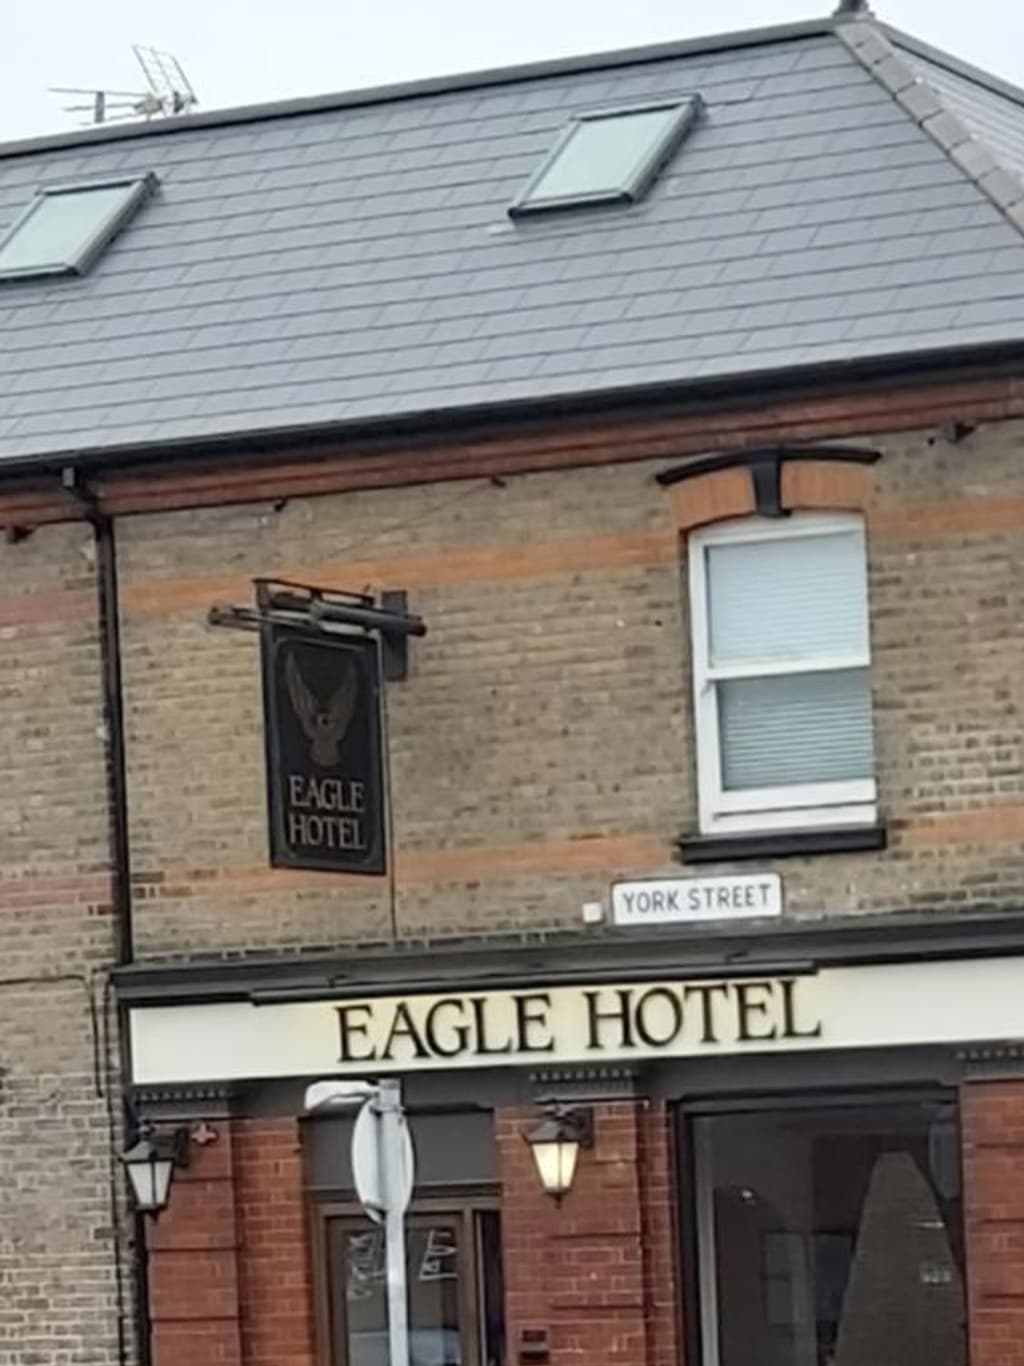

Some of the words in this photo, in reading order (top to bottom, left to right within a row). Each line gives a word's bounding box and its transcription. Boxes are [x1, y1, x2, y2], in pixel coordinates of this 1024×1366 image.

[288, 775, 366, 812] EAGLE
[288, 813, 367, 849] HOTEL
[621, 889, 680, 914] YORK
[687, 883, 772, 911] STREET
[334, 992, 556, 1063] EAGLE
[582, 979, 823, 1050] HOTEL
